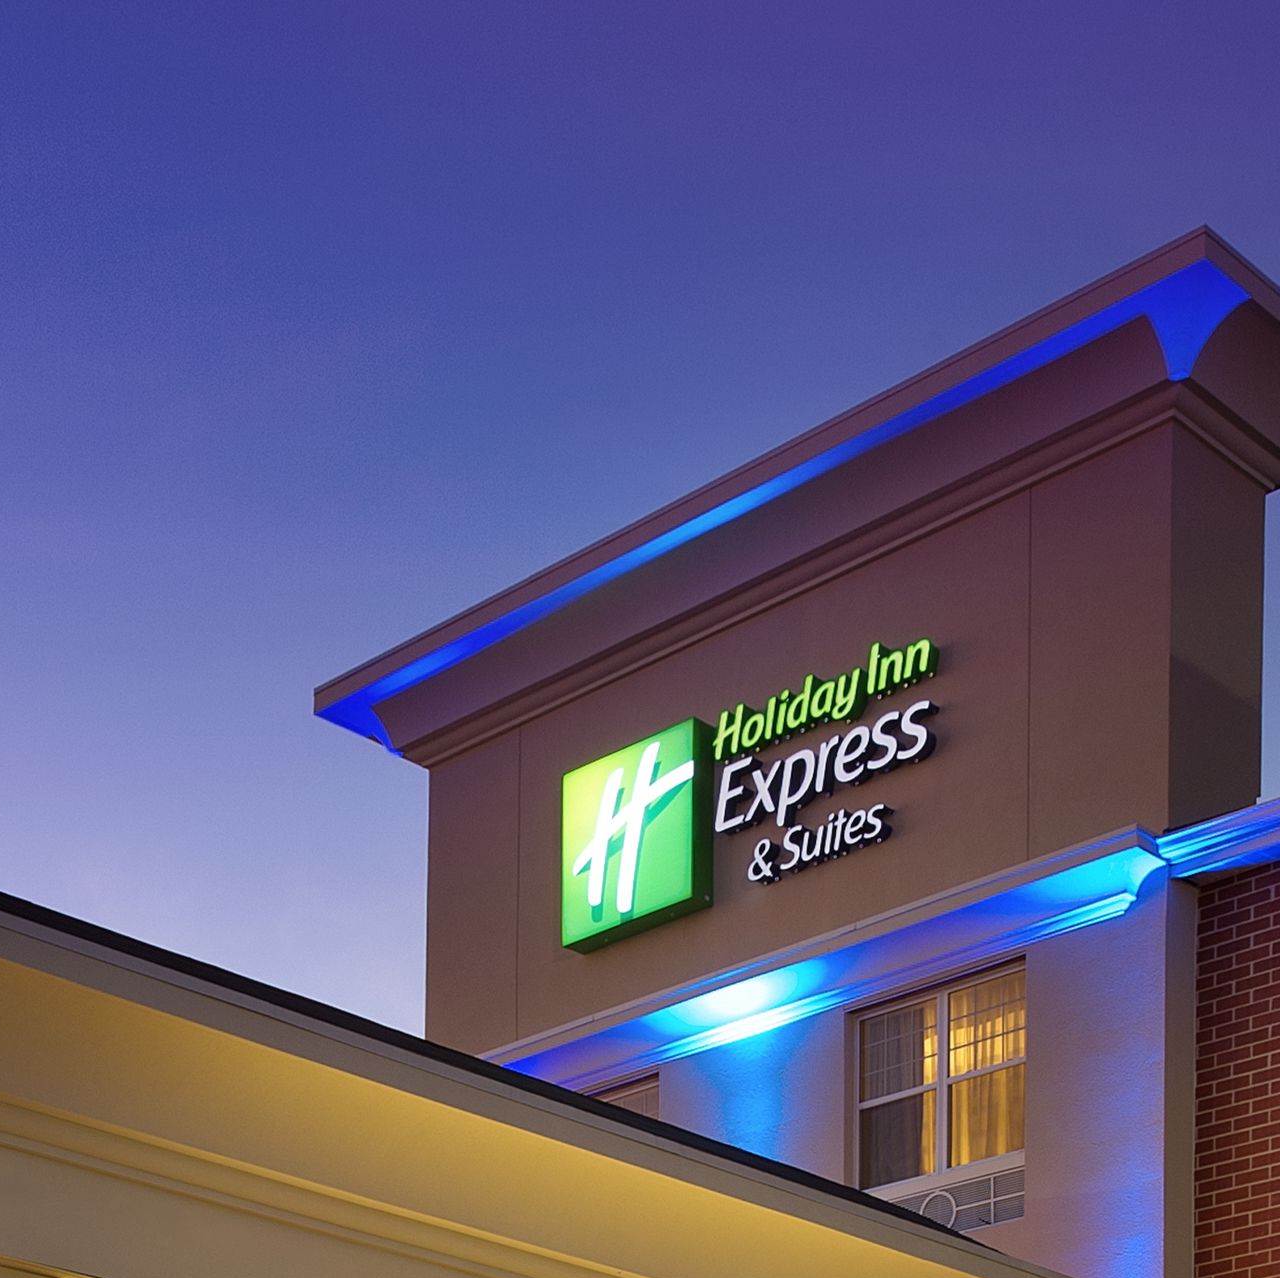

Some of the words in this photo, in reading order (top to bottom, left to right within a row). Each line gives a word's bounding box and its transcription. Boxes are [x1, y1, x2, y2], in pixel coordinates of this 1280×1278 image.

[713, 668, 860, 760] Holiday
[867, 638, 931, 694] Inn
[715, 700, 930, 832] Express
[748, 838, 773, 881] &
[780, 803, 885, 870] Suites
